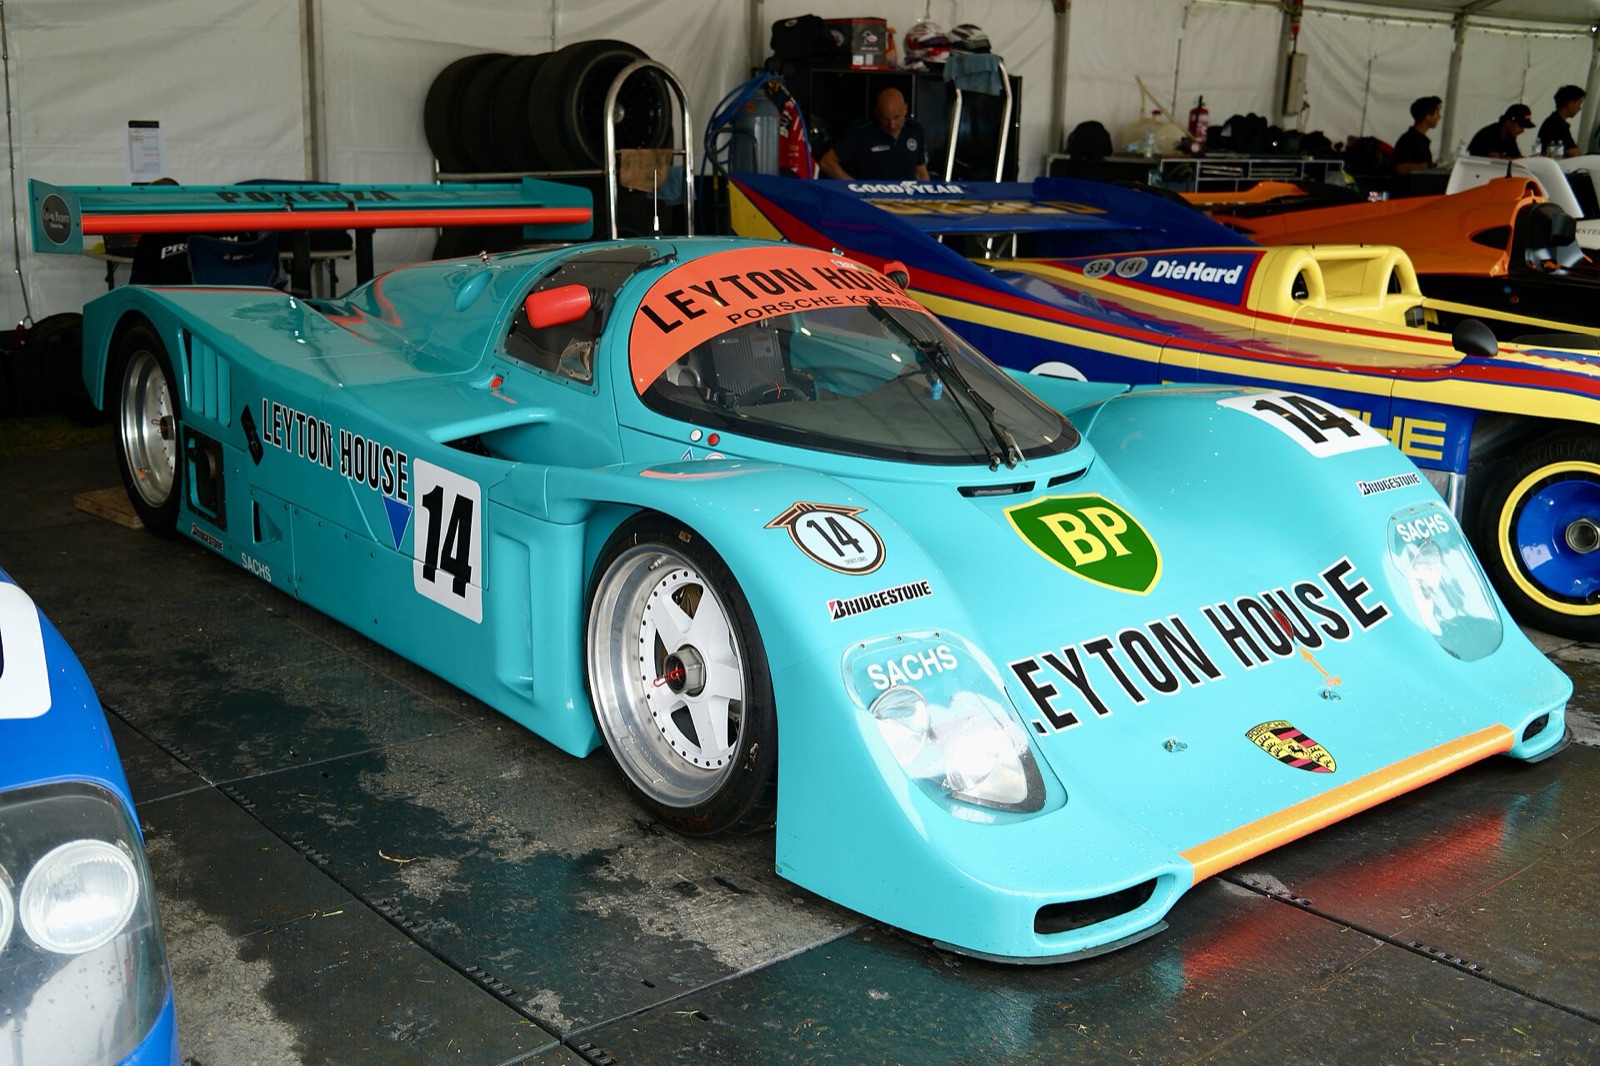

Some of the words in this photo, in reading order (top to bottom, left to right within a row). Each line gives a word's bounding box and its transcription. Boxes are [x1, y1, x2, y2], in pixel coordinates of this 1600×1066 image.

[215, 190, 399, 203] POTENZA
[847, 181, 965, 196] GOODYEAR
[1151, 259, 1243, 285] DieHard
[640, 267, 818, 334] LEYTON
[726, 296, 845, 325] PORSCHE
[1252, 395, 1361, 444] 14
[262, 398, 334, 470] LEYTON
[339, 428, 409, 503] HOUSE
[1358, 473, 1420, 496] BRIDGESTONE
[422, 484, 474, 599] 14
[806, 516, 864, 557] 14
[1037, 506, 1133, 567] BP
[1395, 513, 1450, 543] SACHS
[241, 551, 272, 583] SACHS
[829, 581, 932, 620] BRIDGESTONE
[1010, 616, 1224, 735] EYTON
[1202, 558, 1389, 668] HOUSE
[866, 644, 958, 690] SACHS
